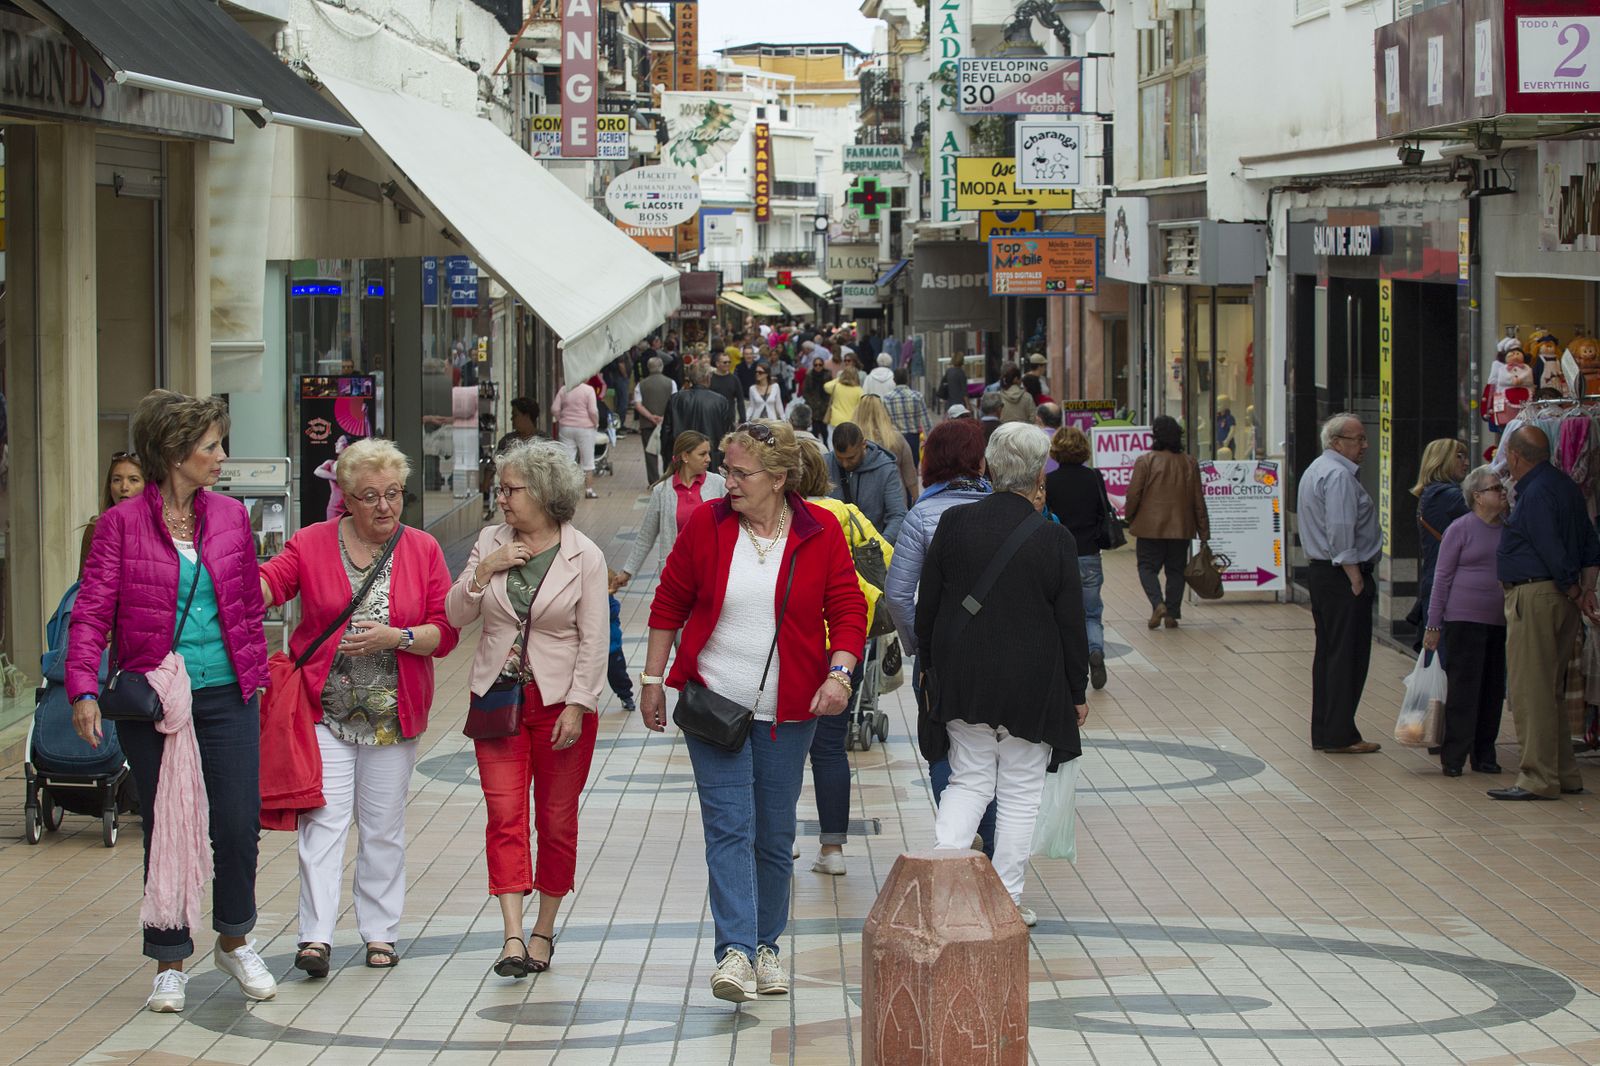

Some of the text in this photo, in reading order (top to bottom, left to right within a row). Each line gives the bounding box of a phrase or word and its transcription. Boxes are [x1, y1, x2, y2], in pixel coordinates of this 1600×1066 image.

[1520, 20, 1559, 28] TODO A
[1553, 23, 1590, 78] 2
[962, 61, 1049, 71] DEVELOPING
[566, 0, 592, 146] ANGE
[962, 73, 1031, 83] REVELADO
[1523, 81, 1590, 90] EVERYTHING
[963, 85, 995, 104] 30
[1016, 92, 1065, 105] Kodak
[598, 118, 626, 130] ORO
[533, 132, 554, 143] WATCH
[1023, 131, 1078, 151] Charanga
[846, 148, 899, 157] FARMACIA
[844, 161, 902, 171] PERFUMERIA
[756, 139, 768, 216] TABACOS
[960, 181, 1007, 195] MODA
[639, 212, 668, 221] BOSS
[620, 226, 674, 237] ADHWANI
[1313, 226, 1335, 255] SALON
[1337, 226, 1346, 255] DE
[830, 257, 843, 269] LA
[844, 287, 876, 296] REGALO
[1381, 285, 1390, 362] SLOT
[1097, 432, 1153, 452] MITAD
